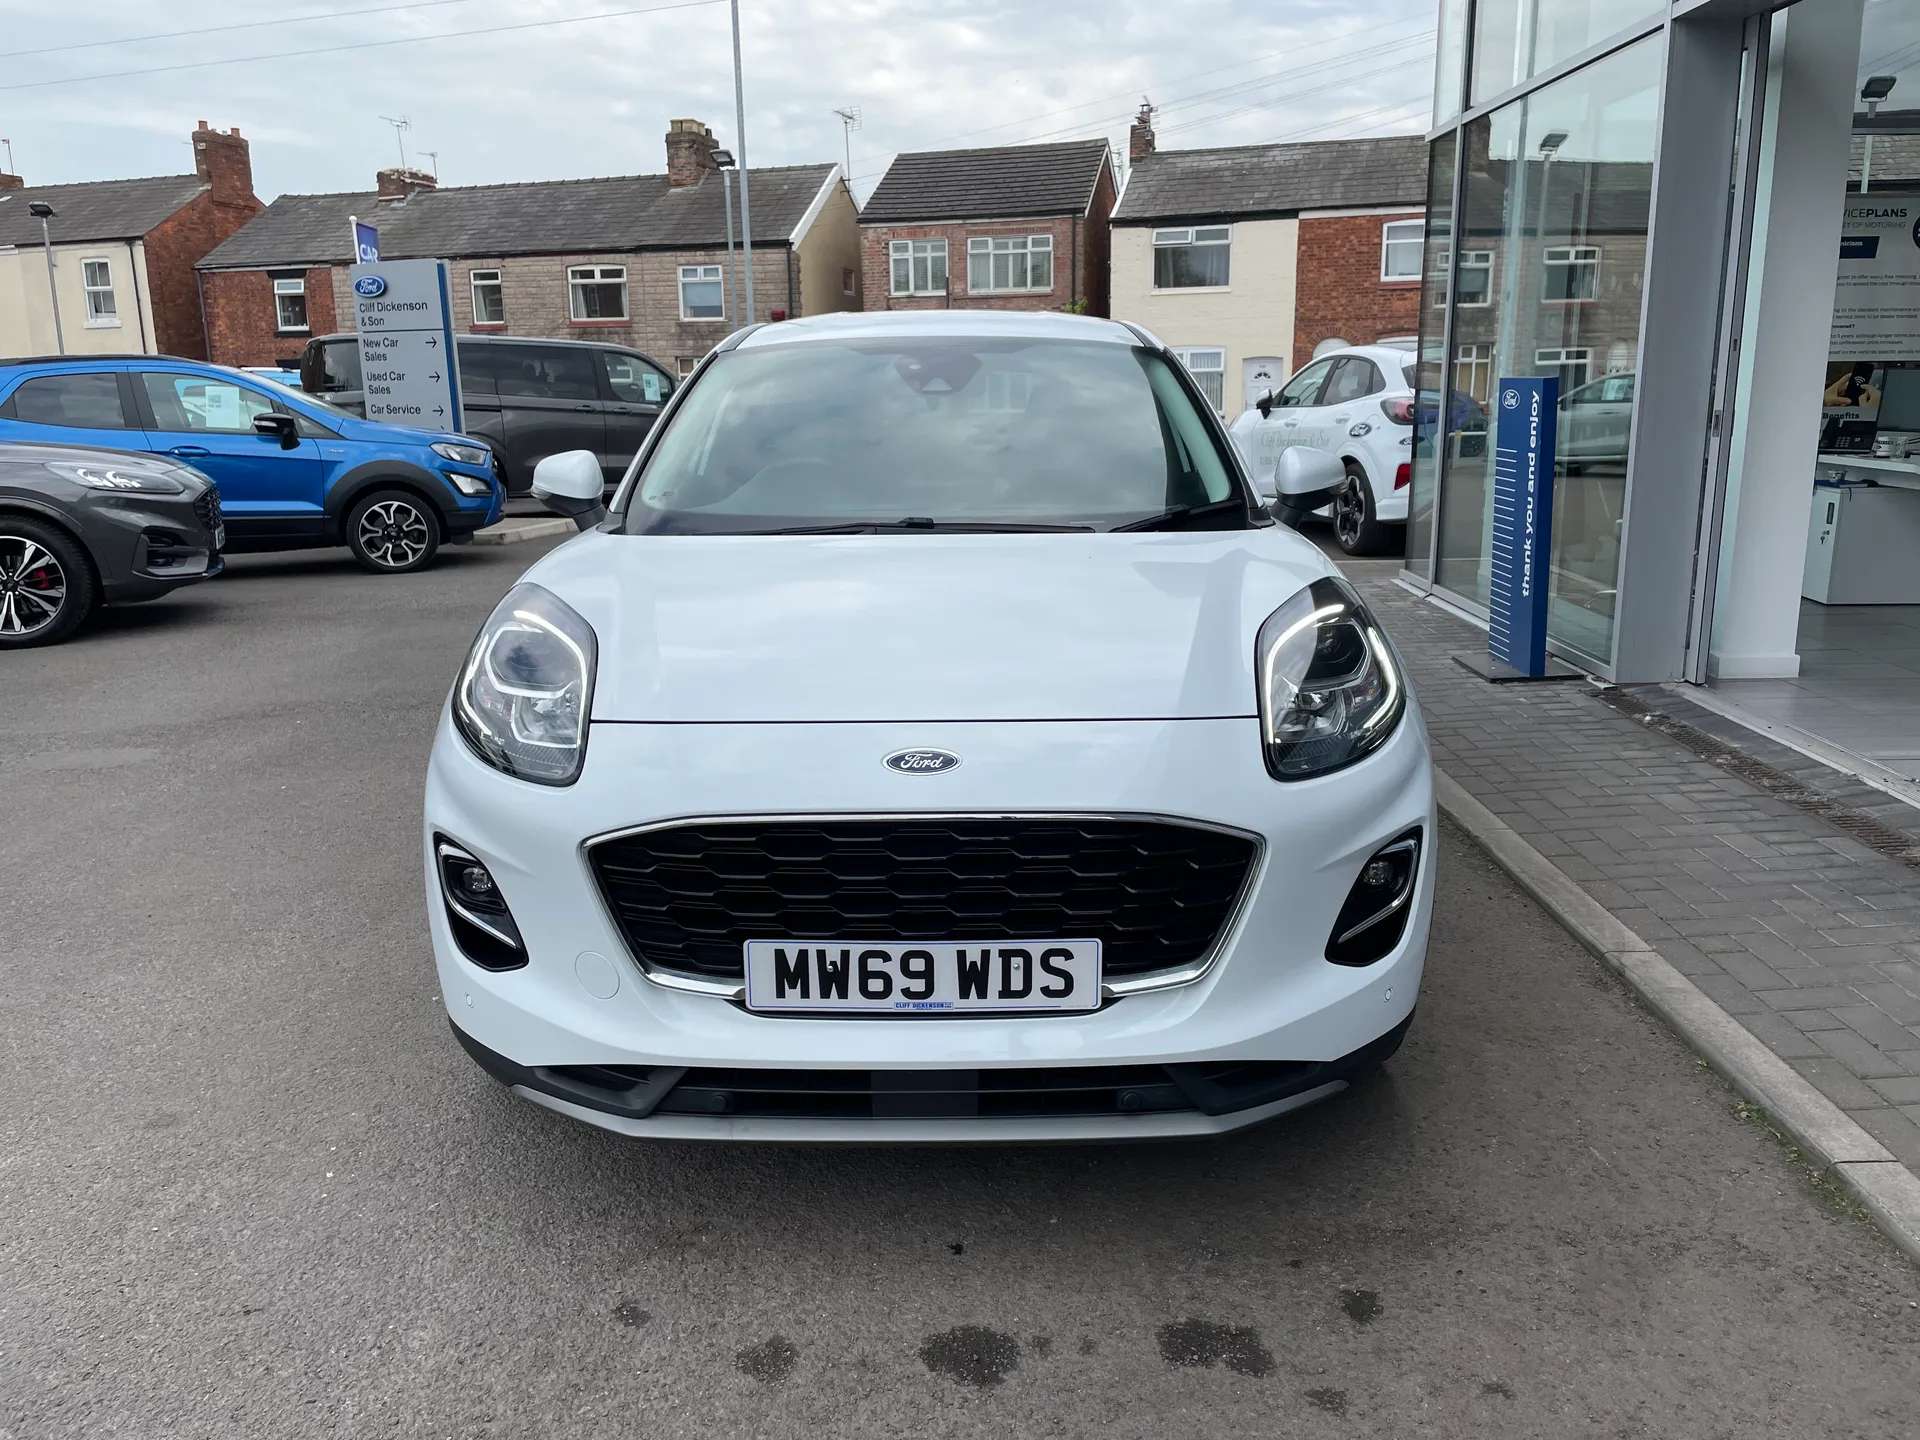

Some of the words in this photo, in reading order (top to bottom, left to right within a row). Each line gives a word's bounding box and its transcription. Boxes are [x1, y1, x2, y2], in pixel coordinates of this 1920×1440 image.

[360, 244, 378, 262] CAR
[360, 279, 378, 293] Ford
[360, 302, 375, 313] Cliff
[376, 302, 428, 312] Dickenson
[361, 317, 367, 326] &
[368, 316, 384, 326] Son
[363, 338, 380, 348] New
[382, 337, 398, 348] Car
[364, 351, 387, 362] Sales
[366, 372, 387, 381] Used
[389, 371, 405, 381] Car
[368, 384, 391, 395] Sales
[370, 404, 384, 414] Car
[386, 404, 421, 415] Service
[1530, 390, 1540, 449] enjoy
[1527, 452, 1536, 493] and
[1522, 538, 1532, 597] thank
[900, 753, 944, 769] Ford
[774, 948, 935, 1000] MW69
[956, 948, 1075, 999] WDS
